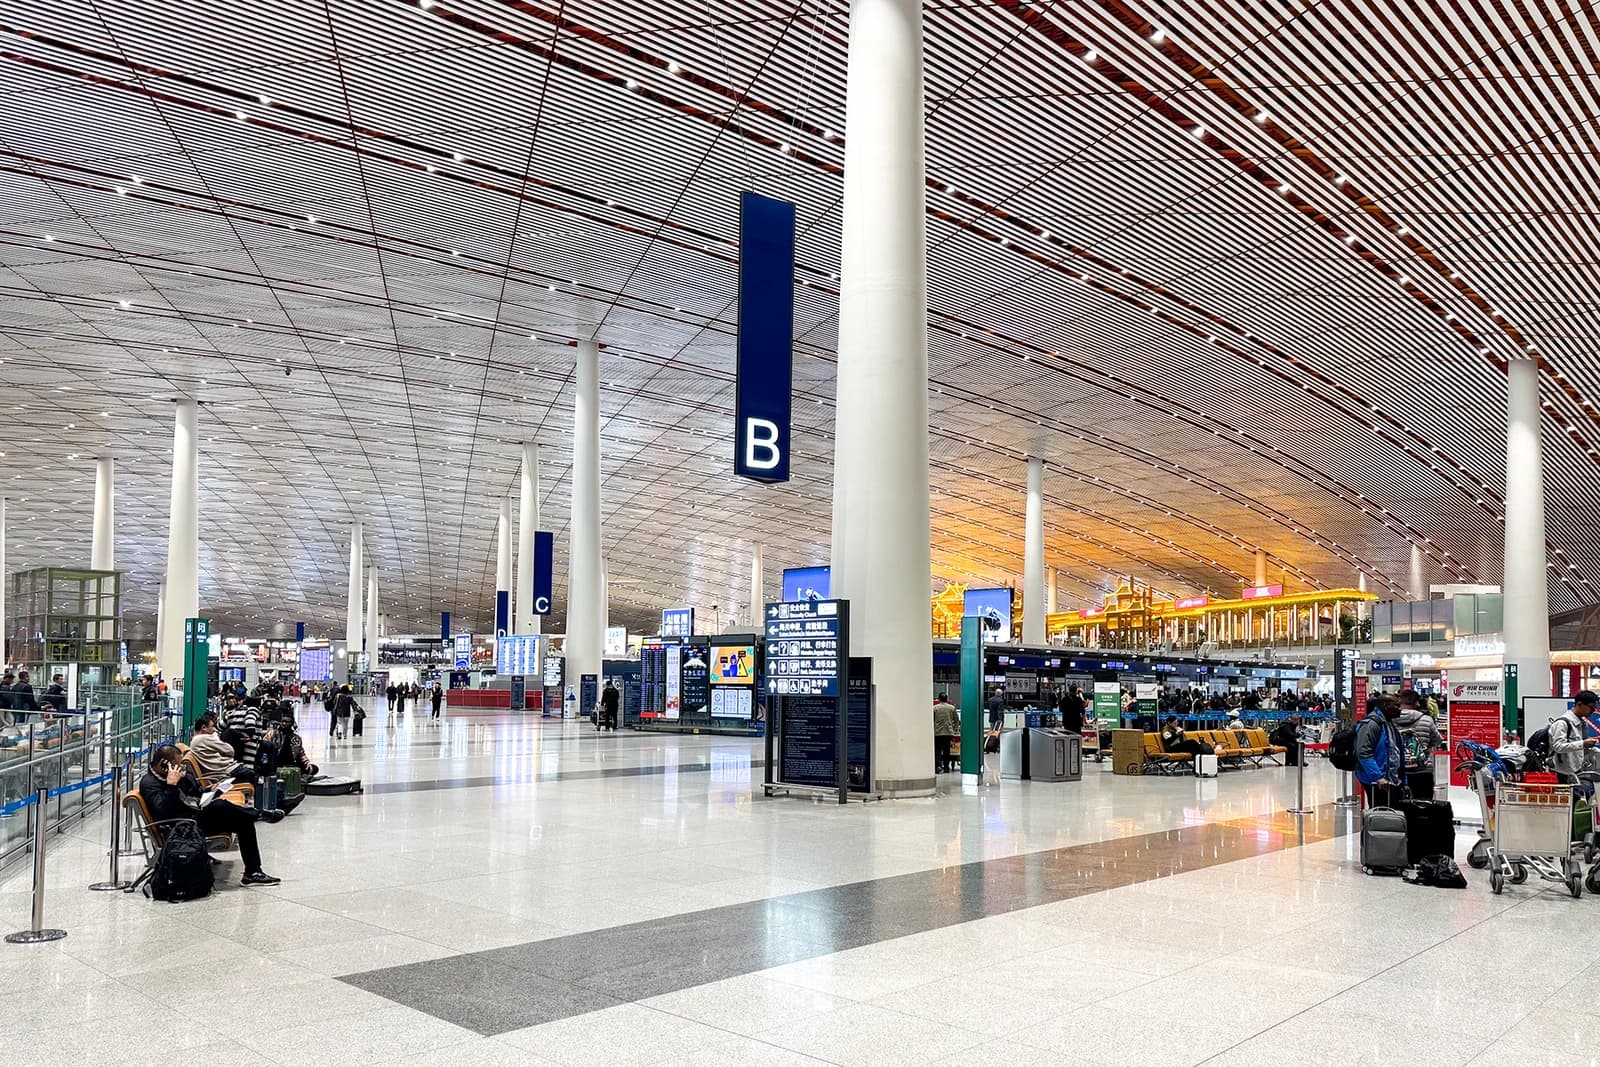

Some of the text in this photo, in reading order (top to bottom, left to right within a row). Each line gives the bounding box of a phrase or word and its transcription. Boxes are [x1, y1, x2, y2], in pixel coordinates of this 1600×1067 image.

[745, 417, 780, 469] B
[535, 597, 549, 613] C
[442, 639, 449, 647] E
